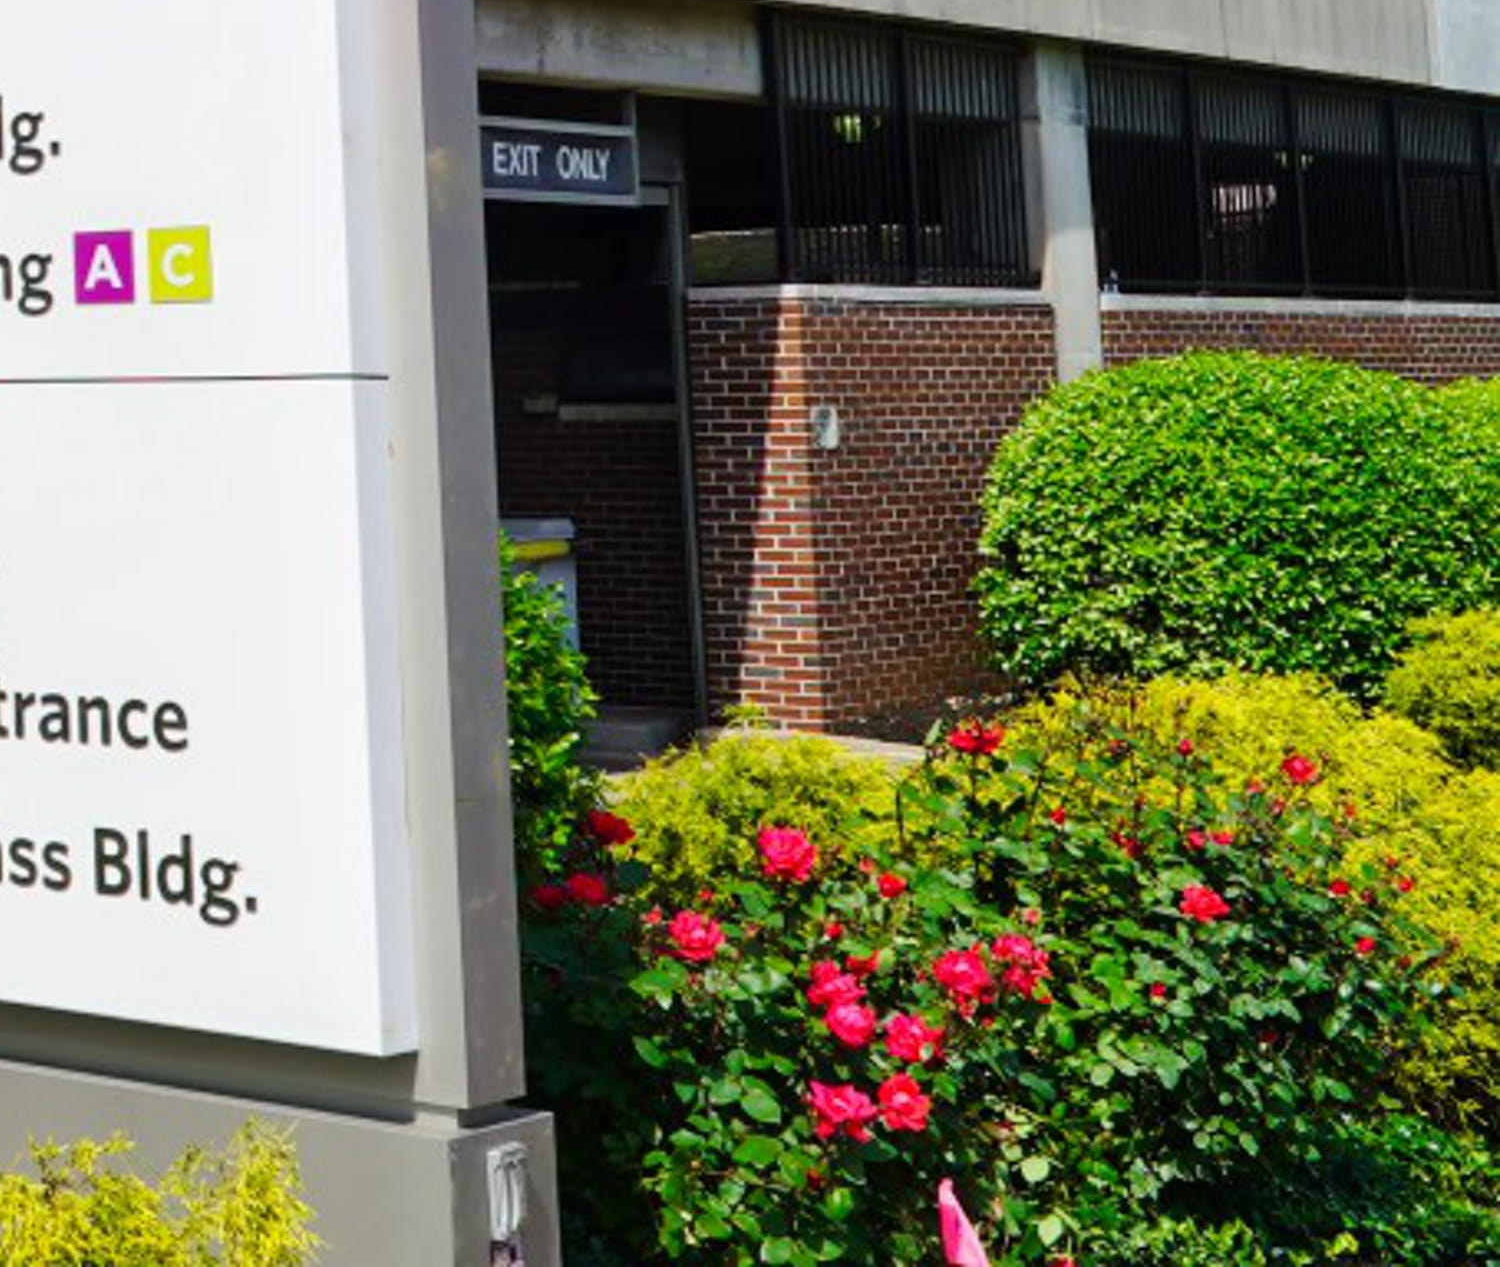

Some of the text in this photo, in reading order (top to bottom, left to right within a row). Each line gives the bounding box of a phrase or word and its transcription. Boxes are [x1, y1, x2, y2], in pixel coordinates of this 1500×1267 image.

[491, 140, 611, 182] EXIT ONLY
[83, 243, 124, 291] A
[159, 241, 196, 289] C
[92, 826, 258, 928] Bldg.
